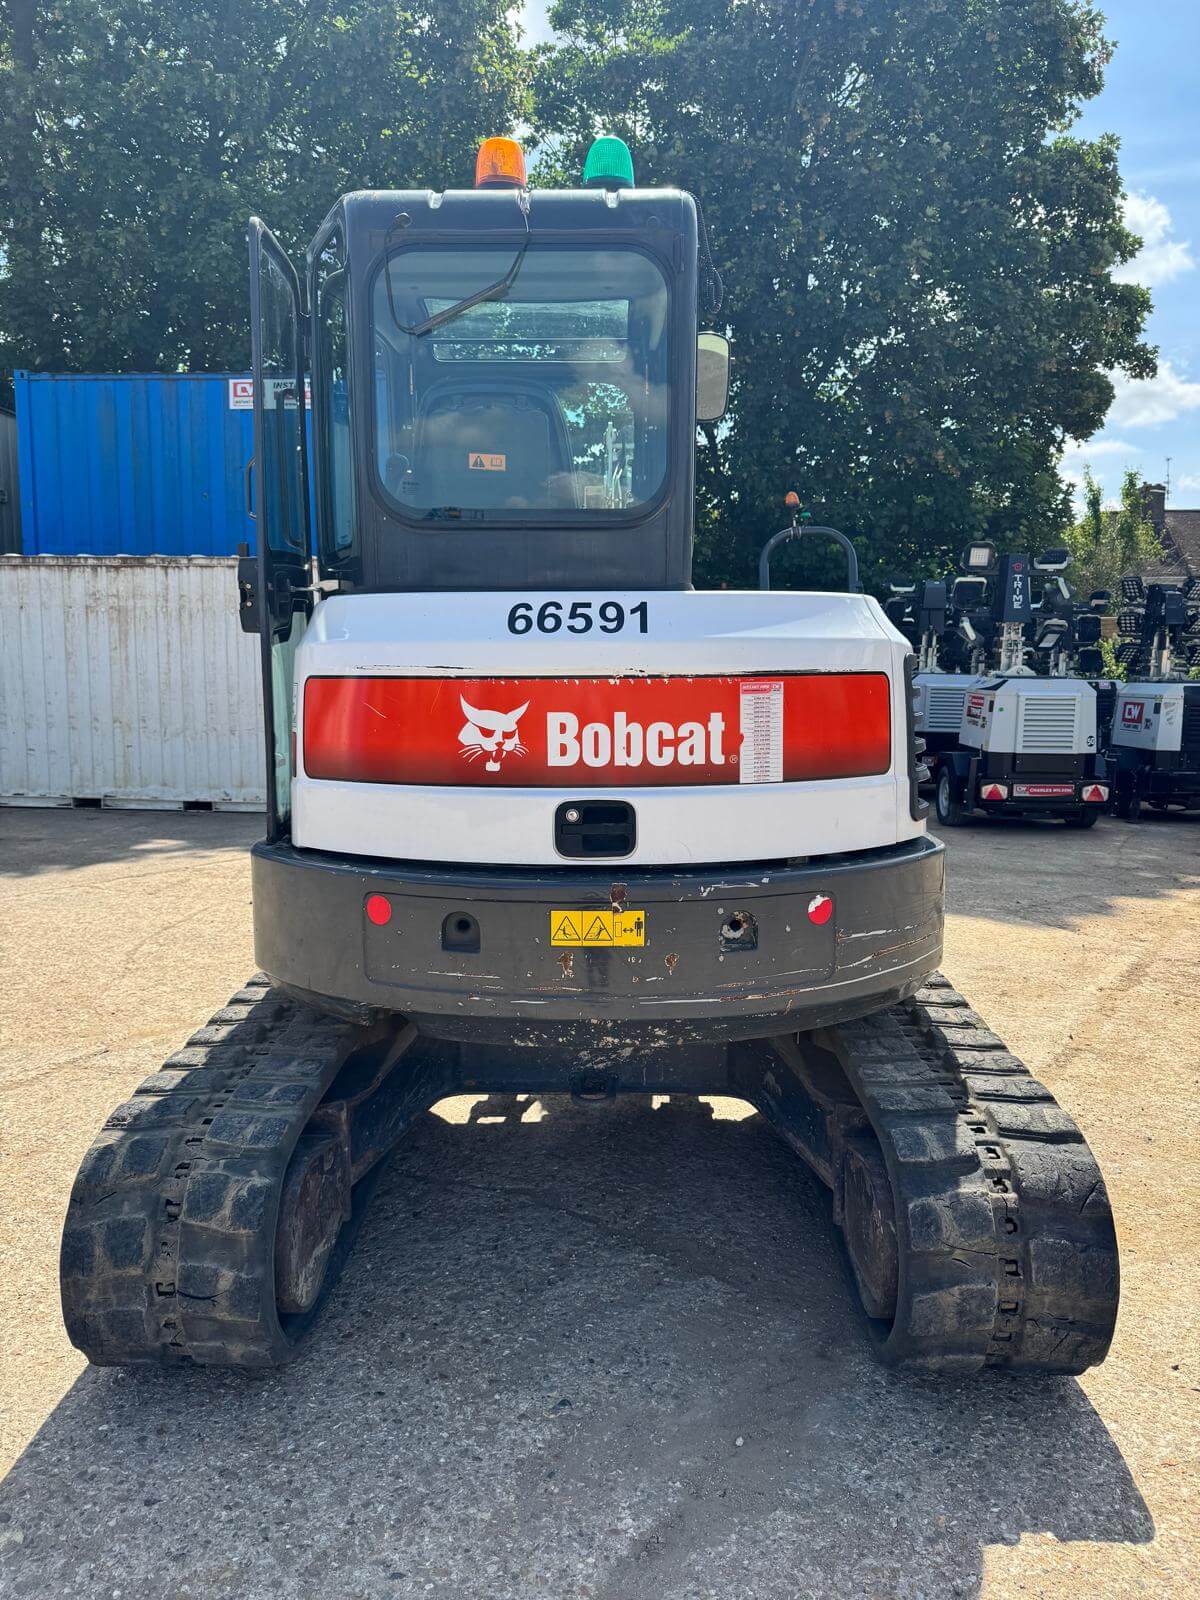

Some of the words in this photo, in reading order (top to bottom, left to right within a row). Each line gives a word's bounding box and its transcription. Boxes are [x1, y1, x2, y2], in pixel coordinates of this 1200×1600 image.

[1012, 574, 1023, 609] TRIME
[507, 600, 648, 635] 66591
[1125, 704, 1141, 720] CW
[546, 711, 726, 767] Bobcat
